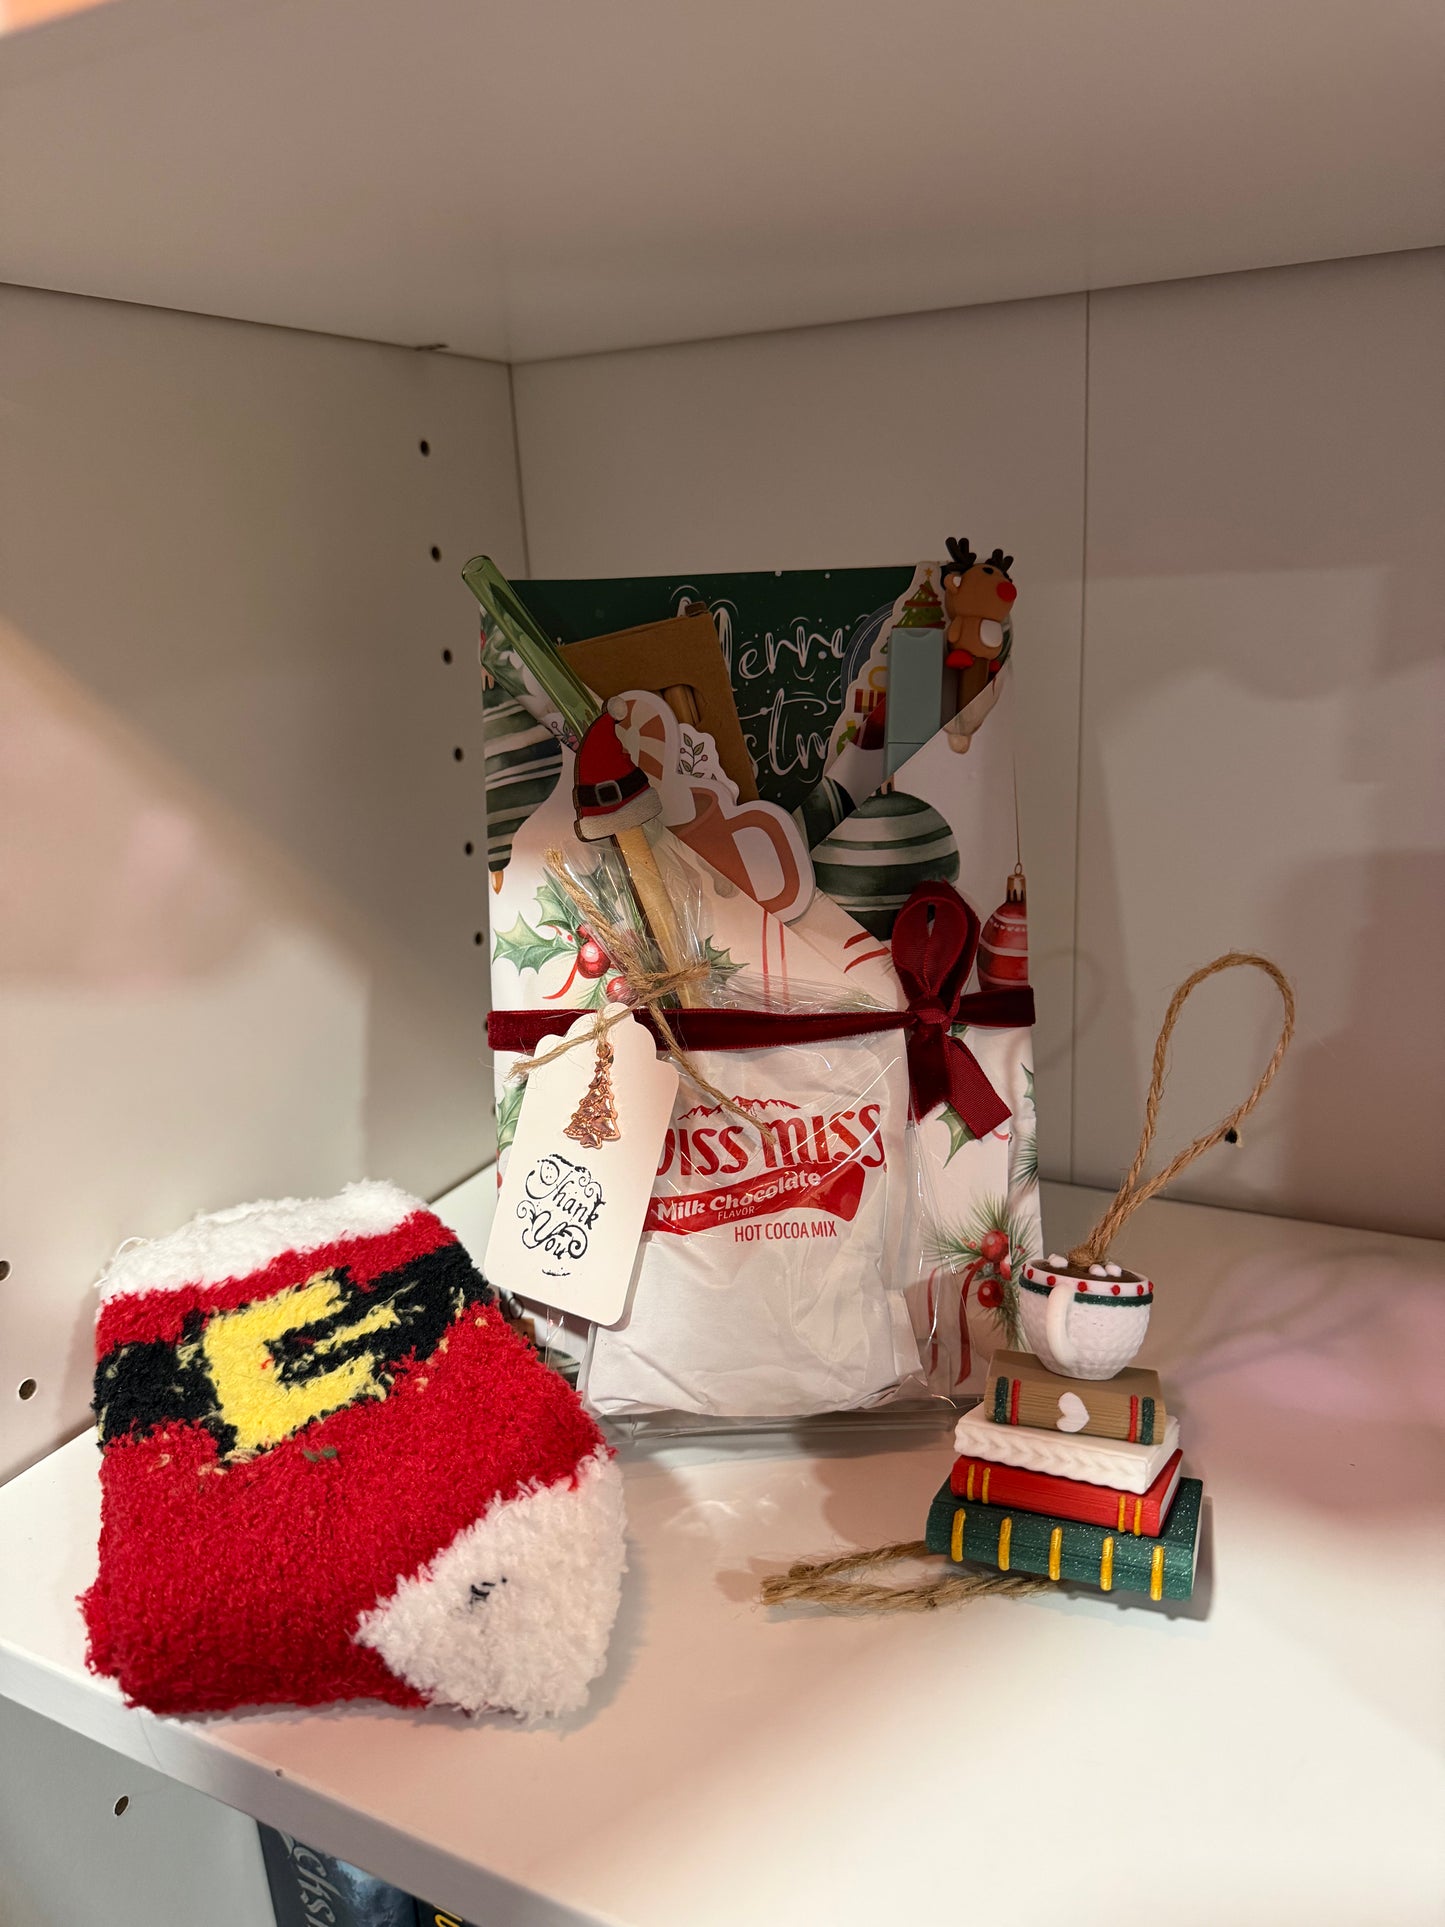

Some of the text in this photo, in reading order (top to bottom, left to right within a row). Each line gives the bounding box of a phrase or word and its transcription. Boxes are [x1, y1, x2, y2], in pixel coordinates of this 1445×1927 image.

[656, 1126, 749, 1176] ISS
[525, 1154, 606, 1230] Thank
[656, 1171, 822, 1221] Milk Chocolate
[717, 1205, 754, 1221] FLAVOR
[516, 1200, 588, 1260] You
[734, 1220, 838, 1243] HOT COCOA MIX
